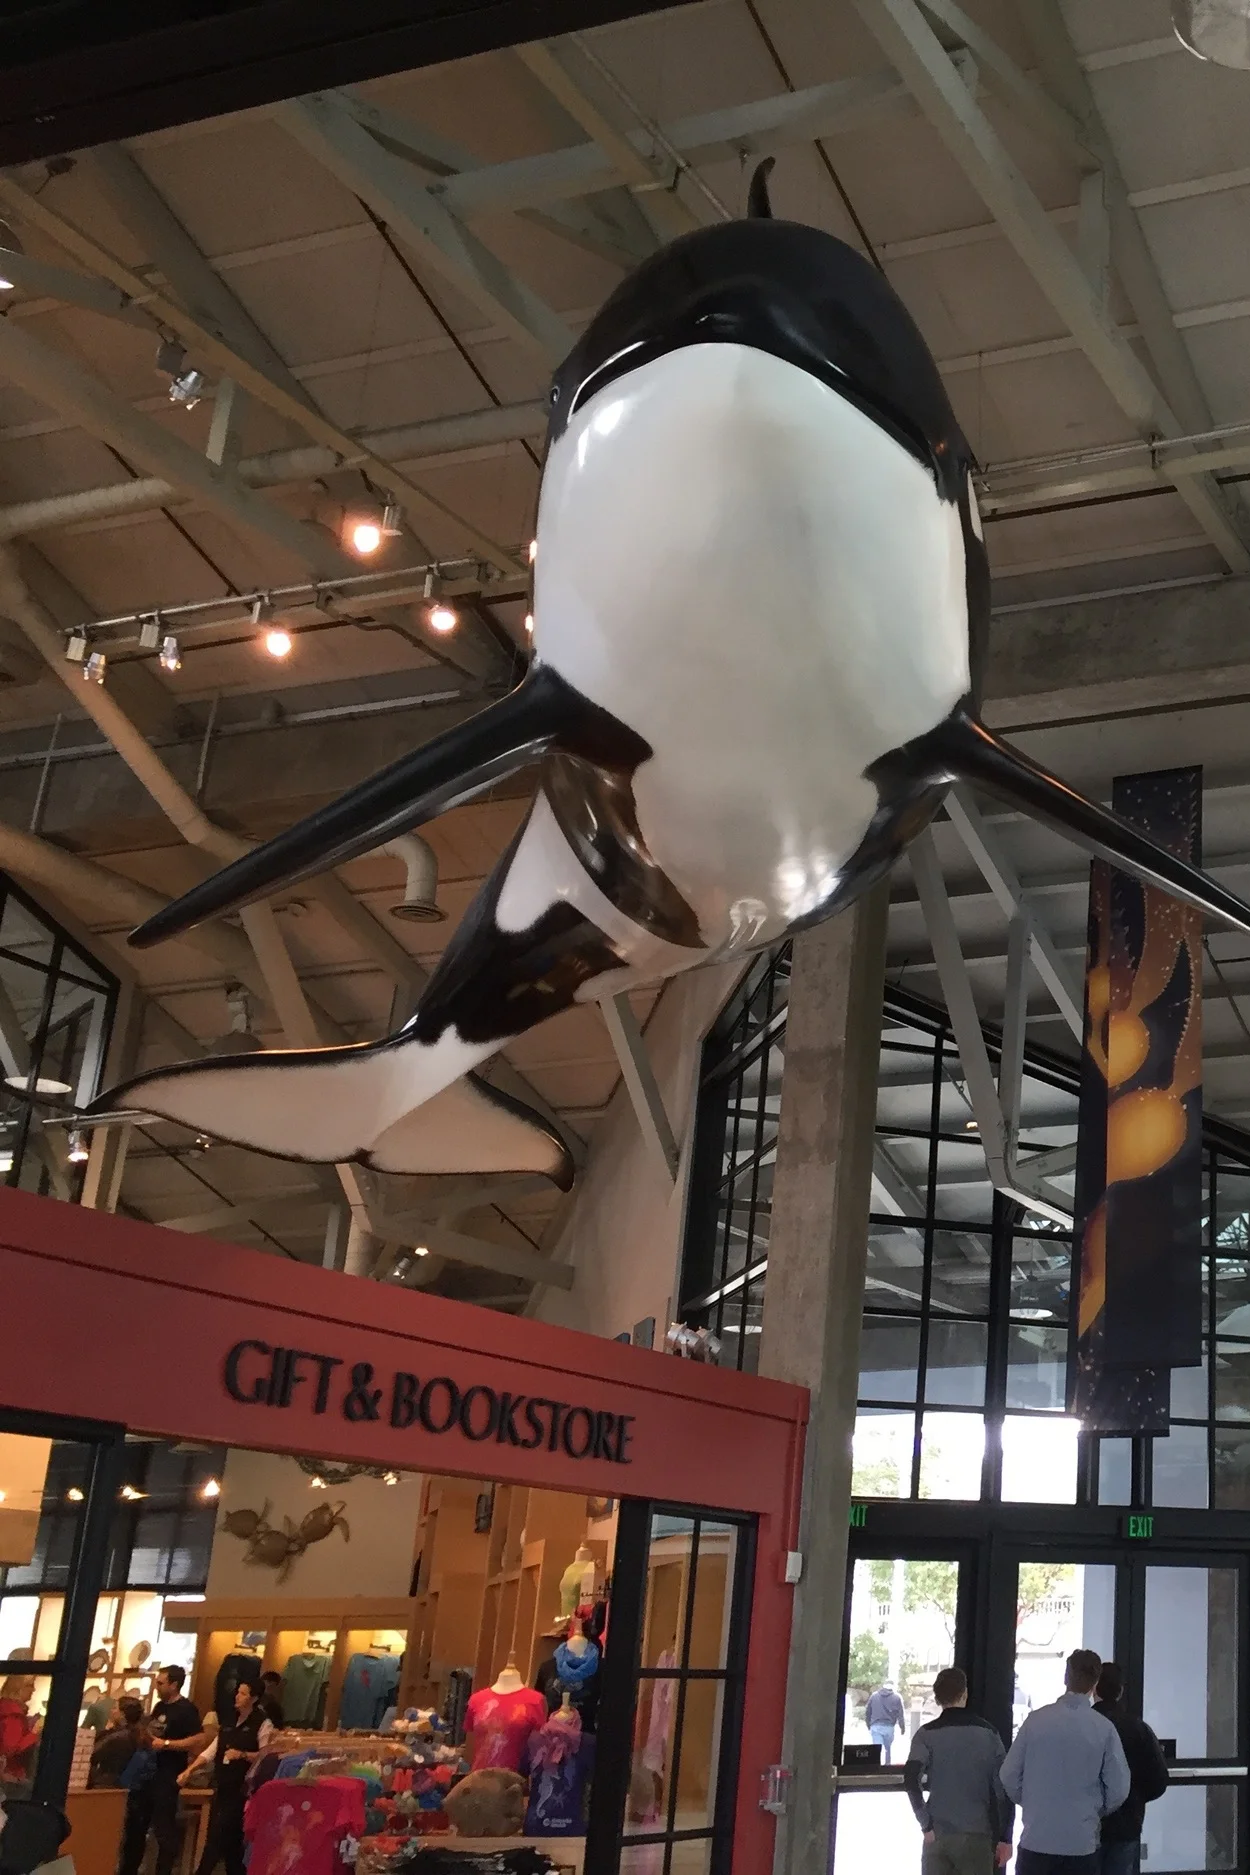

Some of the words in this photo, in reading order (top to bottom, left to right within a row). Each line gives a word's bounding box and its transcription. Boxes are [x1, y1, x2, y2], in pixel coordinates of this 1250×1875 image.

[223, 1339, 343, 1414] GIFT
[343, 1361, 381, 1423] &
[389, 1371, 636, 1464] BOOKSTORE
[848, 1504, 868, 1527] XIT
[1130, 1516, 1154, 1537] EXIT
